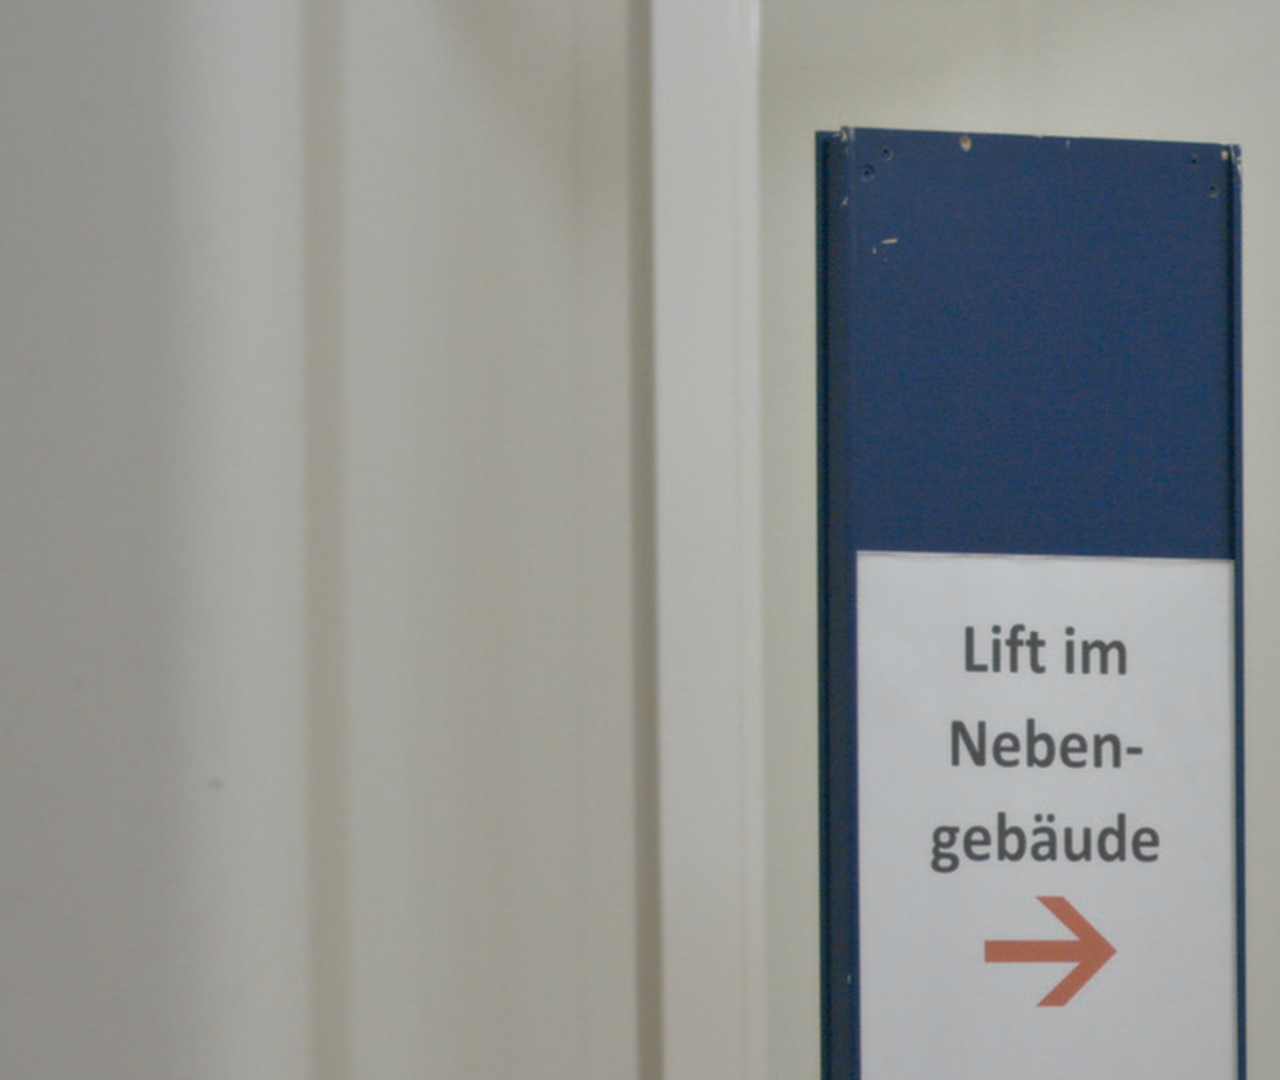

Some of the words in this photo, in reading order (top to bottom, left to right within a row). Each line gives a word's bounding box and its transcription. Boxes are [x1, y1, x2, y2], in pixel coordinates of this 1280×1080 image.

[964, 622, 1047, 675] Lift
[1064, 624, 1127, 676] im
[950, 716, 1144, 769] Neben-
[930, 811, 1161, 875] gebäude
